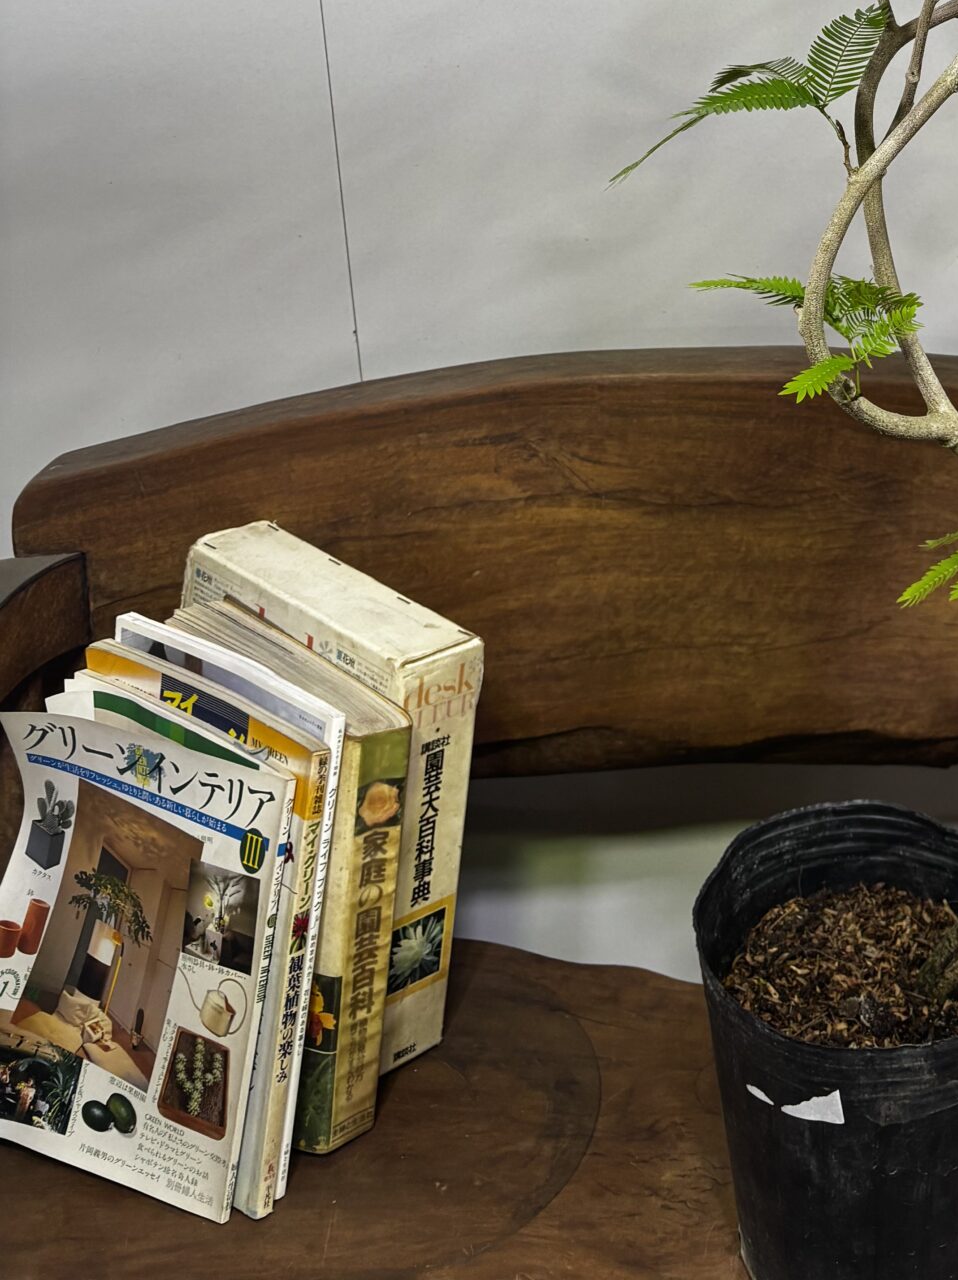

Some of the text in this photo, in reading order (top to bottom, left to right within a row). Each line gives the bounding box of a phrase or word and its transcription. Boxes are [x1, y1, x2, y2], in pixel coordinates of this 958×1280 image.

[421, 734, 450, 755] 講談社
[22, 722, 276, 828] グリーンインテリア
[325, 787, 337, 833] グリーン
[410, 748, 445, 908] 園芸大百科事典
[320, 837, 331, 872] ライフ
[313, 878, 325, 912] ブック
[349, 830, 389, 1020] 家庭の園芸百科
[262, 935, 273, 961] GREEN
[276, 955, 304, 1084] 観葉植物の楽しみ
[145, 1114, 185, 1137] GREEN WORLD
